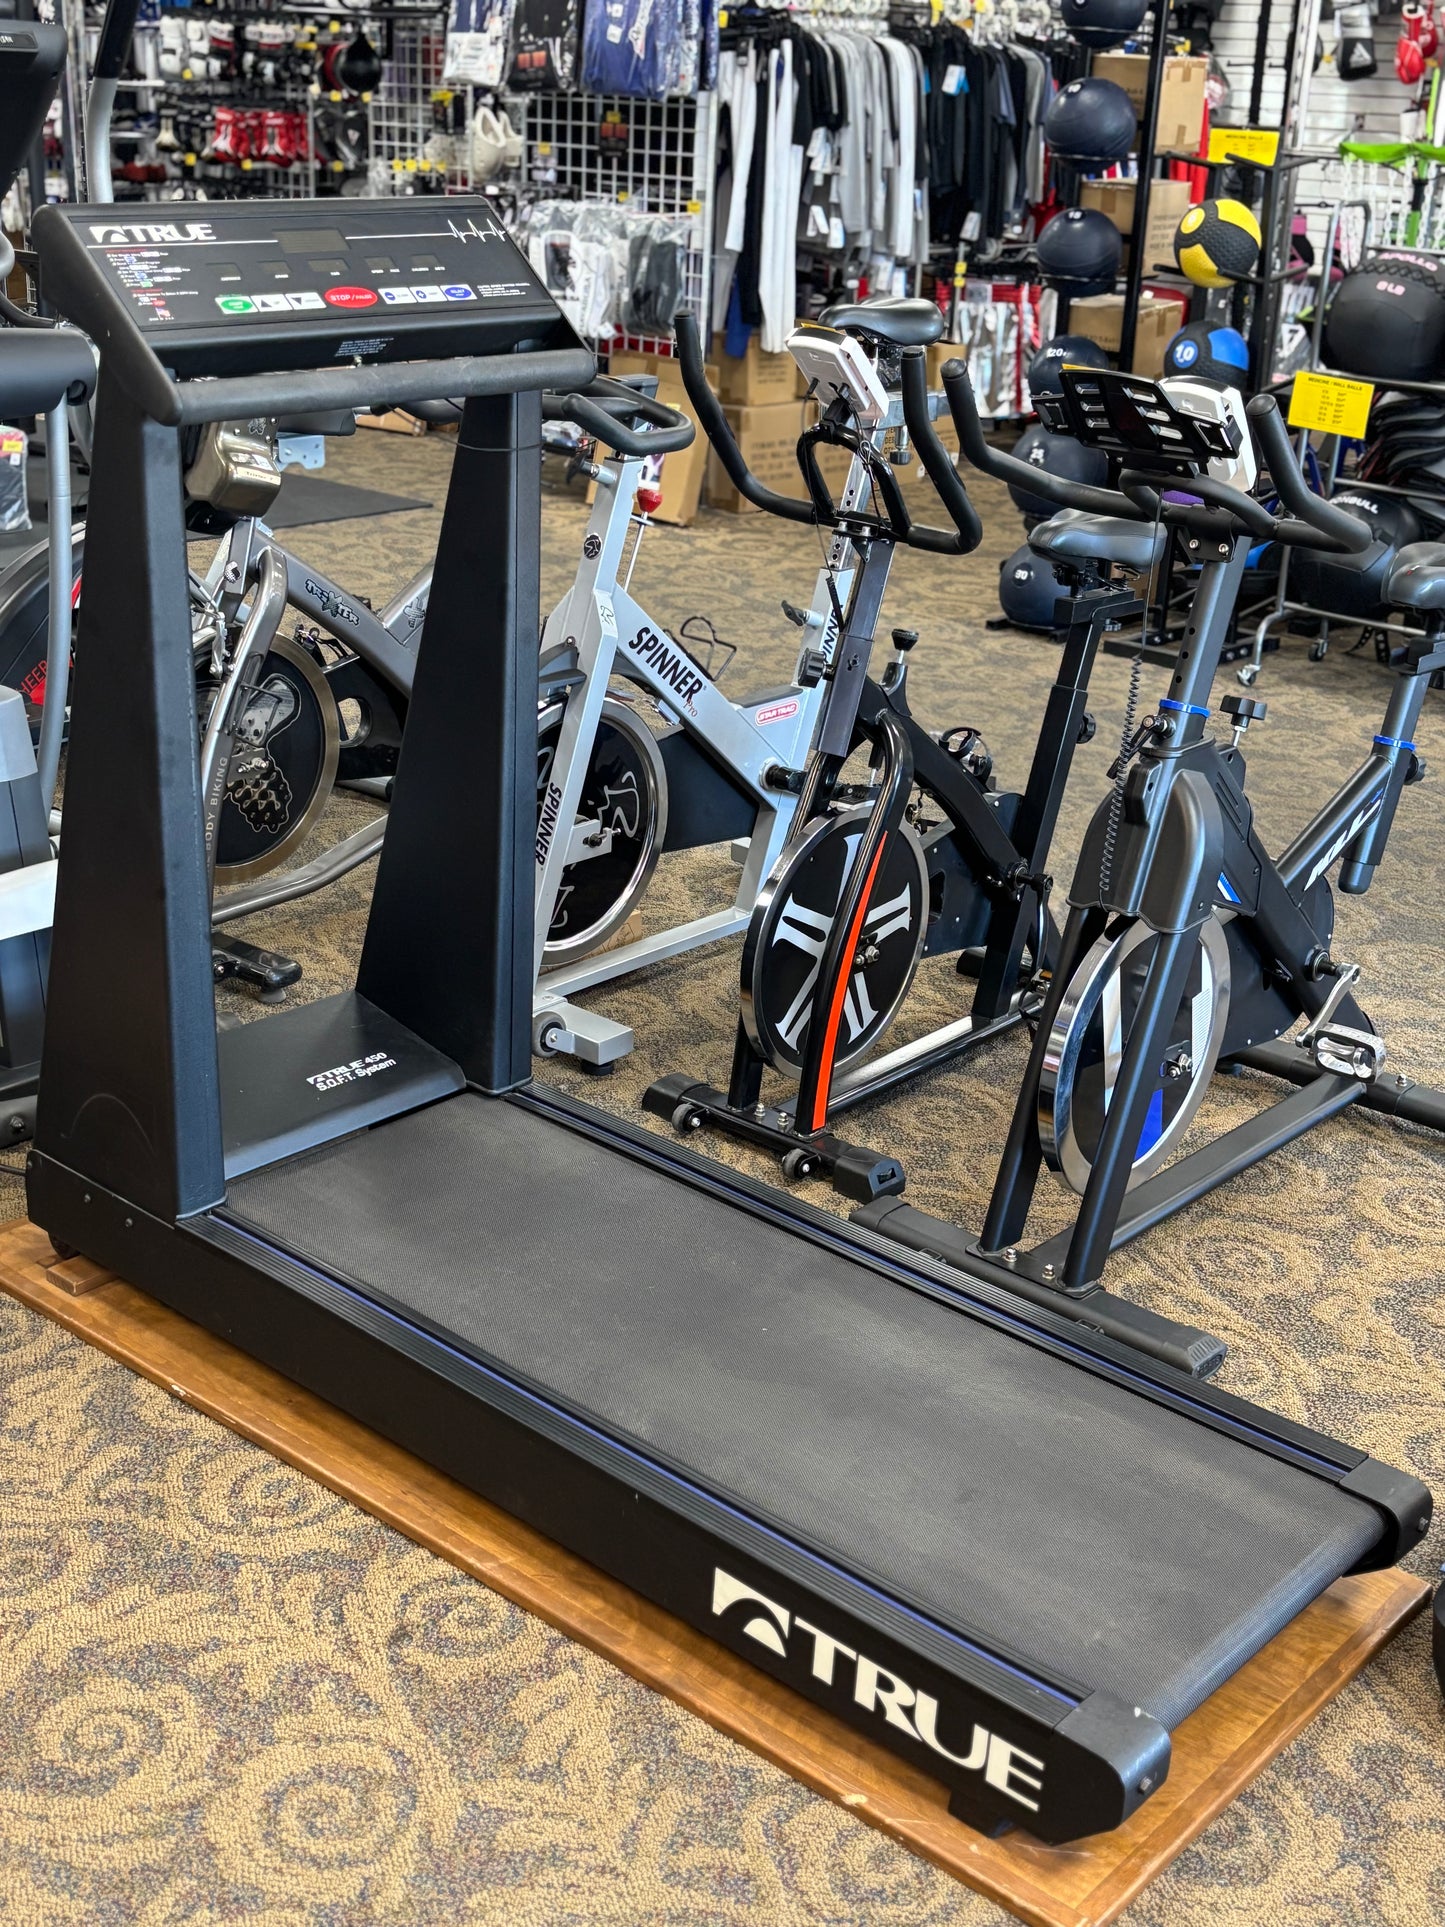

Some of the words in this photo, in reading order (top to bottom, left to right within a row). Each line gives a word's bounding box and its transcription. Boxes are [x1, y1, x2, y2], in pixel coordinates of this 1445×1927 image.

[121, 224, 217, 242] TRUE
[1175, 343, 1196, 361] 10
[1308, 377, 1330, 385] MEDICINE
[628, 626, 704, 702] SPINNER
[210, 756, 228, 806] BIKING
[535, 782, 562, 866] SPINNER
[315, 1072, 357, 1092] S.O.F.T.
[354, 1059, 397, 1077] System
[320, 1059, 366, 1079] TRUE
[365, 1052, 388, 1064] 450
[794, 1616, 1045, 1813] TRUE
